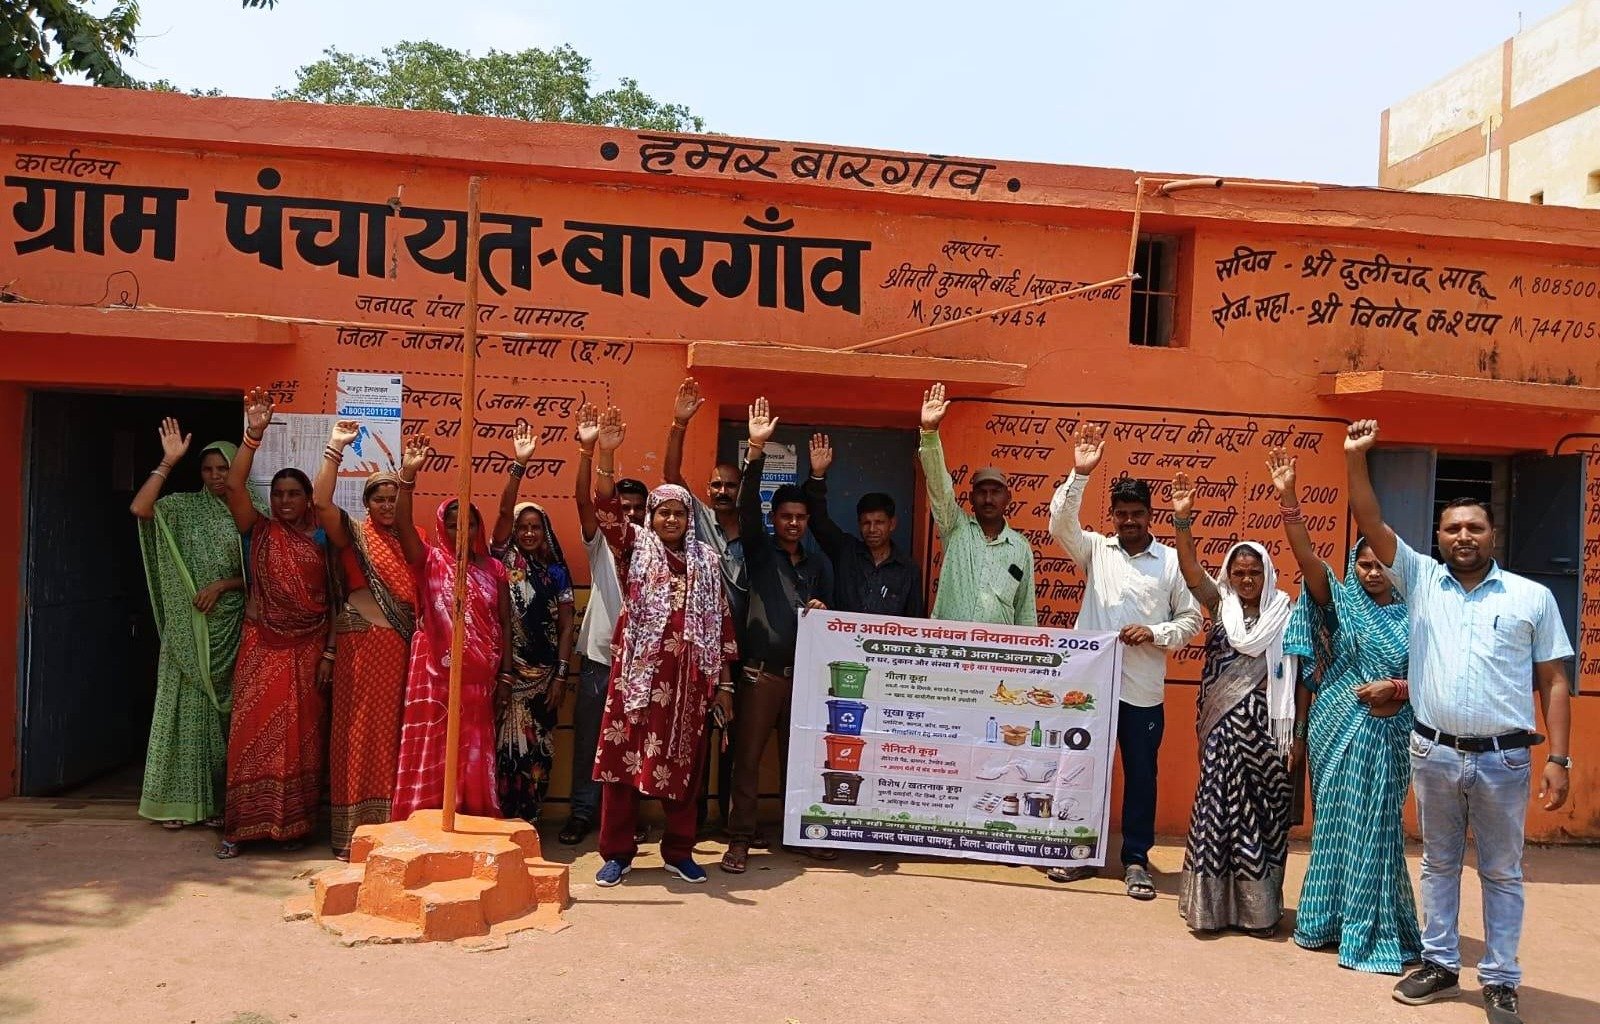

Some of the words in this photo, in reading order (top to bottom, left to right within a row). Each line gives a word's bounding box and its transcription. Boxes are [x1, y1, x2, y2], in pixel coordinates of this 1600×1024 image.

[15, 149, 121, 180] कार्यालय
[637, 135, 781, 179] हमर
[5, 175, 190, 262] ग्राम
[880, 262, 938, 291] श्रीमती
[935, 268, 991, 298] कुमारी
[989, 269, 1021, 298] बाई
[1215, 245, 1277, 283] सचिव
[1301, 249, 1337, 279] श्री
[1340, 254, 1432, 293] दुलीचंद
[1438, 266, 1497, 300] साहू
[355, 295, 418, 319] जनपद
[425, 294, 499, 322] पंचात
[1306, 292, 1343, 326] श्री
[1350, 296, 1421, 337] विनोद
[1426, 308, 1503, 338] कश्यप
[1529, 317, 1600, 343] 744705
[985, 410, 1052, 436] सरपंच
[1055, 411, 1080, 442] एवं
[1113, 418, 1186, 445] सरपंच
[1187, 418, 1214, 444] की
[1215, 421, 1258, 453] सूची
[1261, 424, 1295, 449] वर्ष
[1293, 431, 1323, 454] वार
[991, 440, 1055, 461] सरपंच
[1128, 452, 1154, 466] उप
[1156, 449, 1216, 469] सरपंच
[1301, 485, 1339, 504] 2000
[1247, 513, 1282, 530] 2000
[827, 618, 857, 633] ठोस
[860, 622, 918, 637] अपशिष्ट
[921, 626, 968, 641] प्रबंधन
[1058, 638, 1100, 651] 2026
[871, 643, 879, 651] 4
[882, 643, 911, 654] प्रकार
[914, 644, 925, 654] के
[929, 645, 949, 658] कूड़े
[952, 646, 967, 658] को
[885, 670, 907, 682] गीला
[909, 673, 927, 683] कूड़ा
[883, 708, 903, 718] सूखा
[907, 711, 925, 719] कूड़ा
[881, 742, 915, 754] सैनिटरी
[918, 747, 938, 756] कूड़ा
[878, 778, 900, 788] विशेष
[908, 781, 944, 791] खतरनाक
[830, 826, 864, 840] कार्यालय
[897, 830, 924, 844] पंचायत
